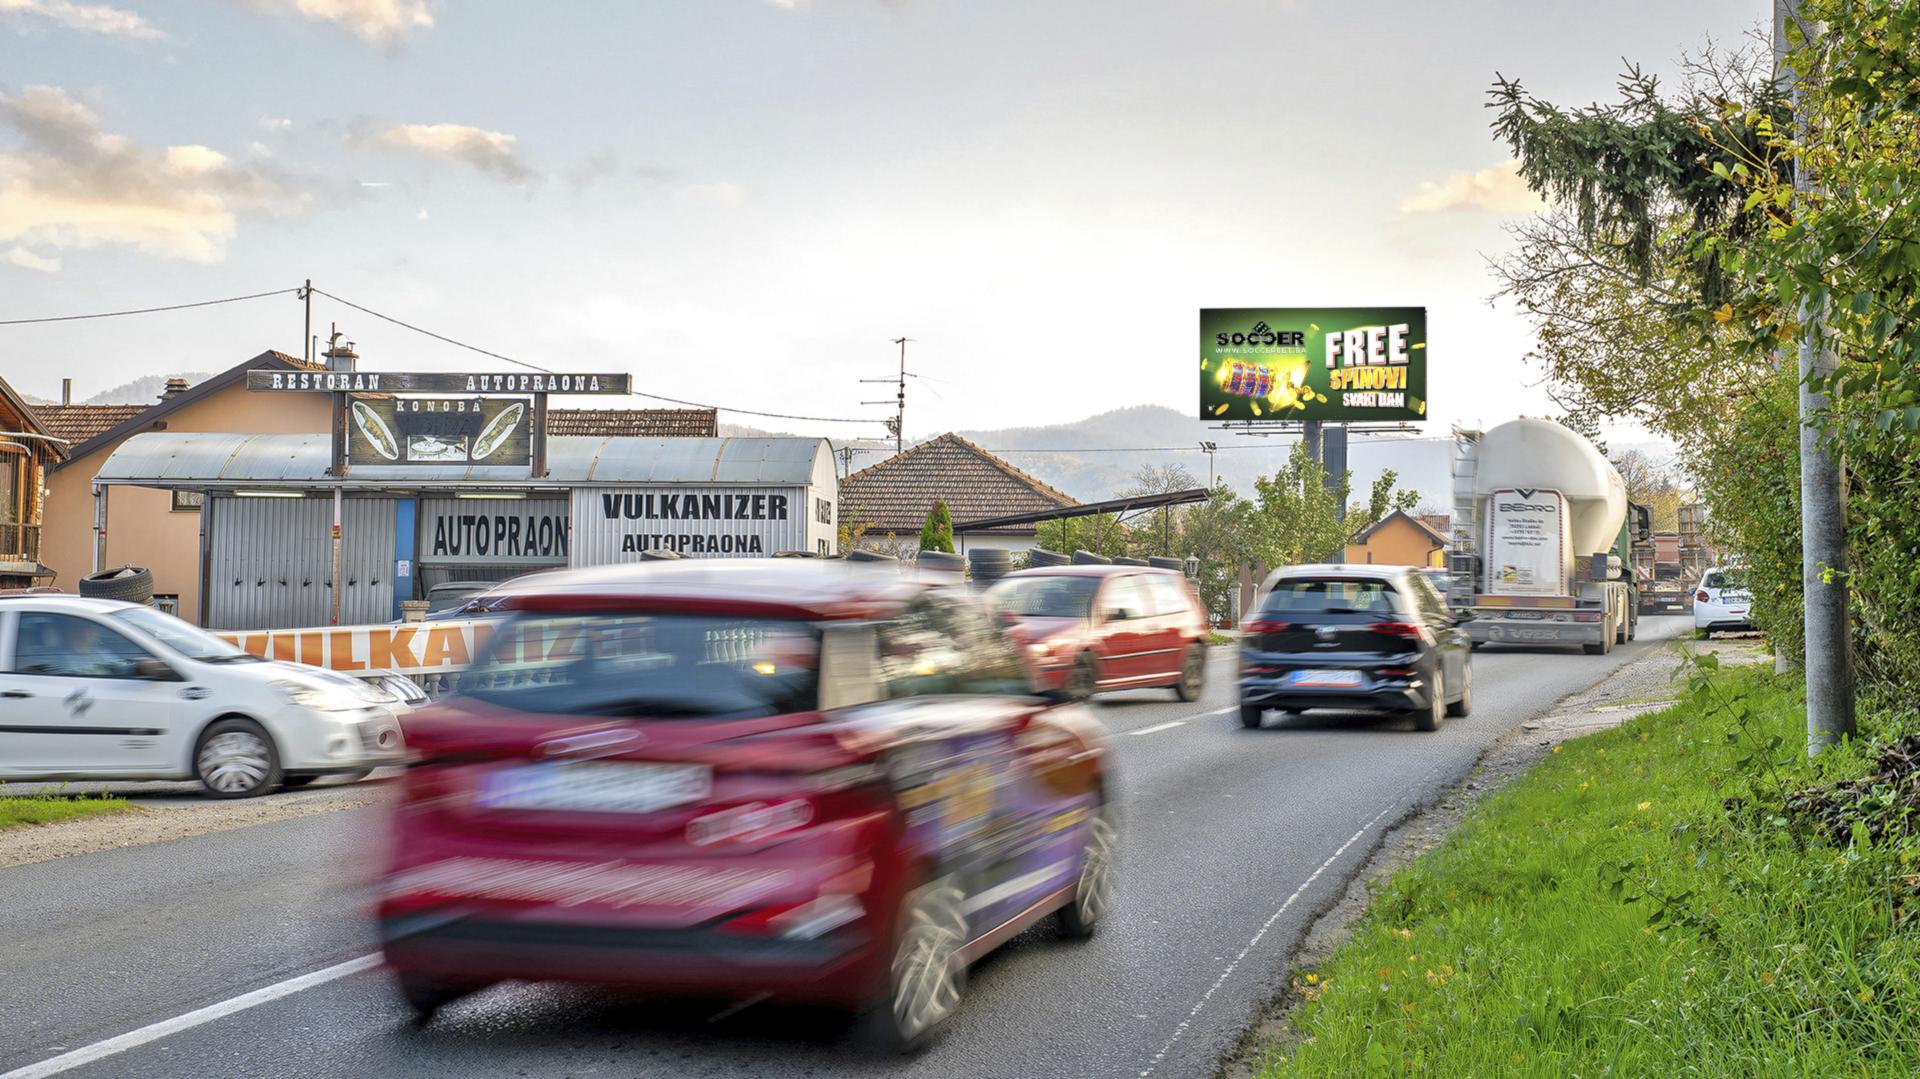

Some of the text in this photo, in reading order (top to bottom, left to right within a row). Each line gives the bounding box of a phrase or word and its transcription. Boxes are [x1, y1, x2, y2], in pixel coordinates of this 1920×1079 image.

[1216, 332, 1304, 345] SOCCER
[1325, 324, 1408, 368] FREE
[272, 373, 600, 391] RESTORAN AUTOPRAONA
[1330, 366, 1407, 391] SPINOVI
[396, 401, 480, 412] KONOBA
[1342, 393, 1405, 408] SVAKI DAN
[602, 494, 787, 520] VULKANIZER
[621, 534, 762, 553] AUTOPRAONA
